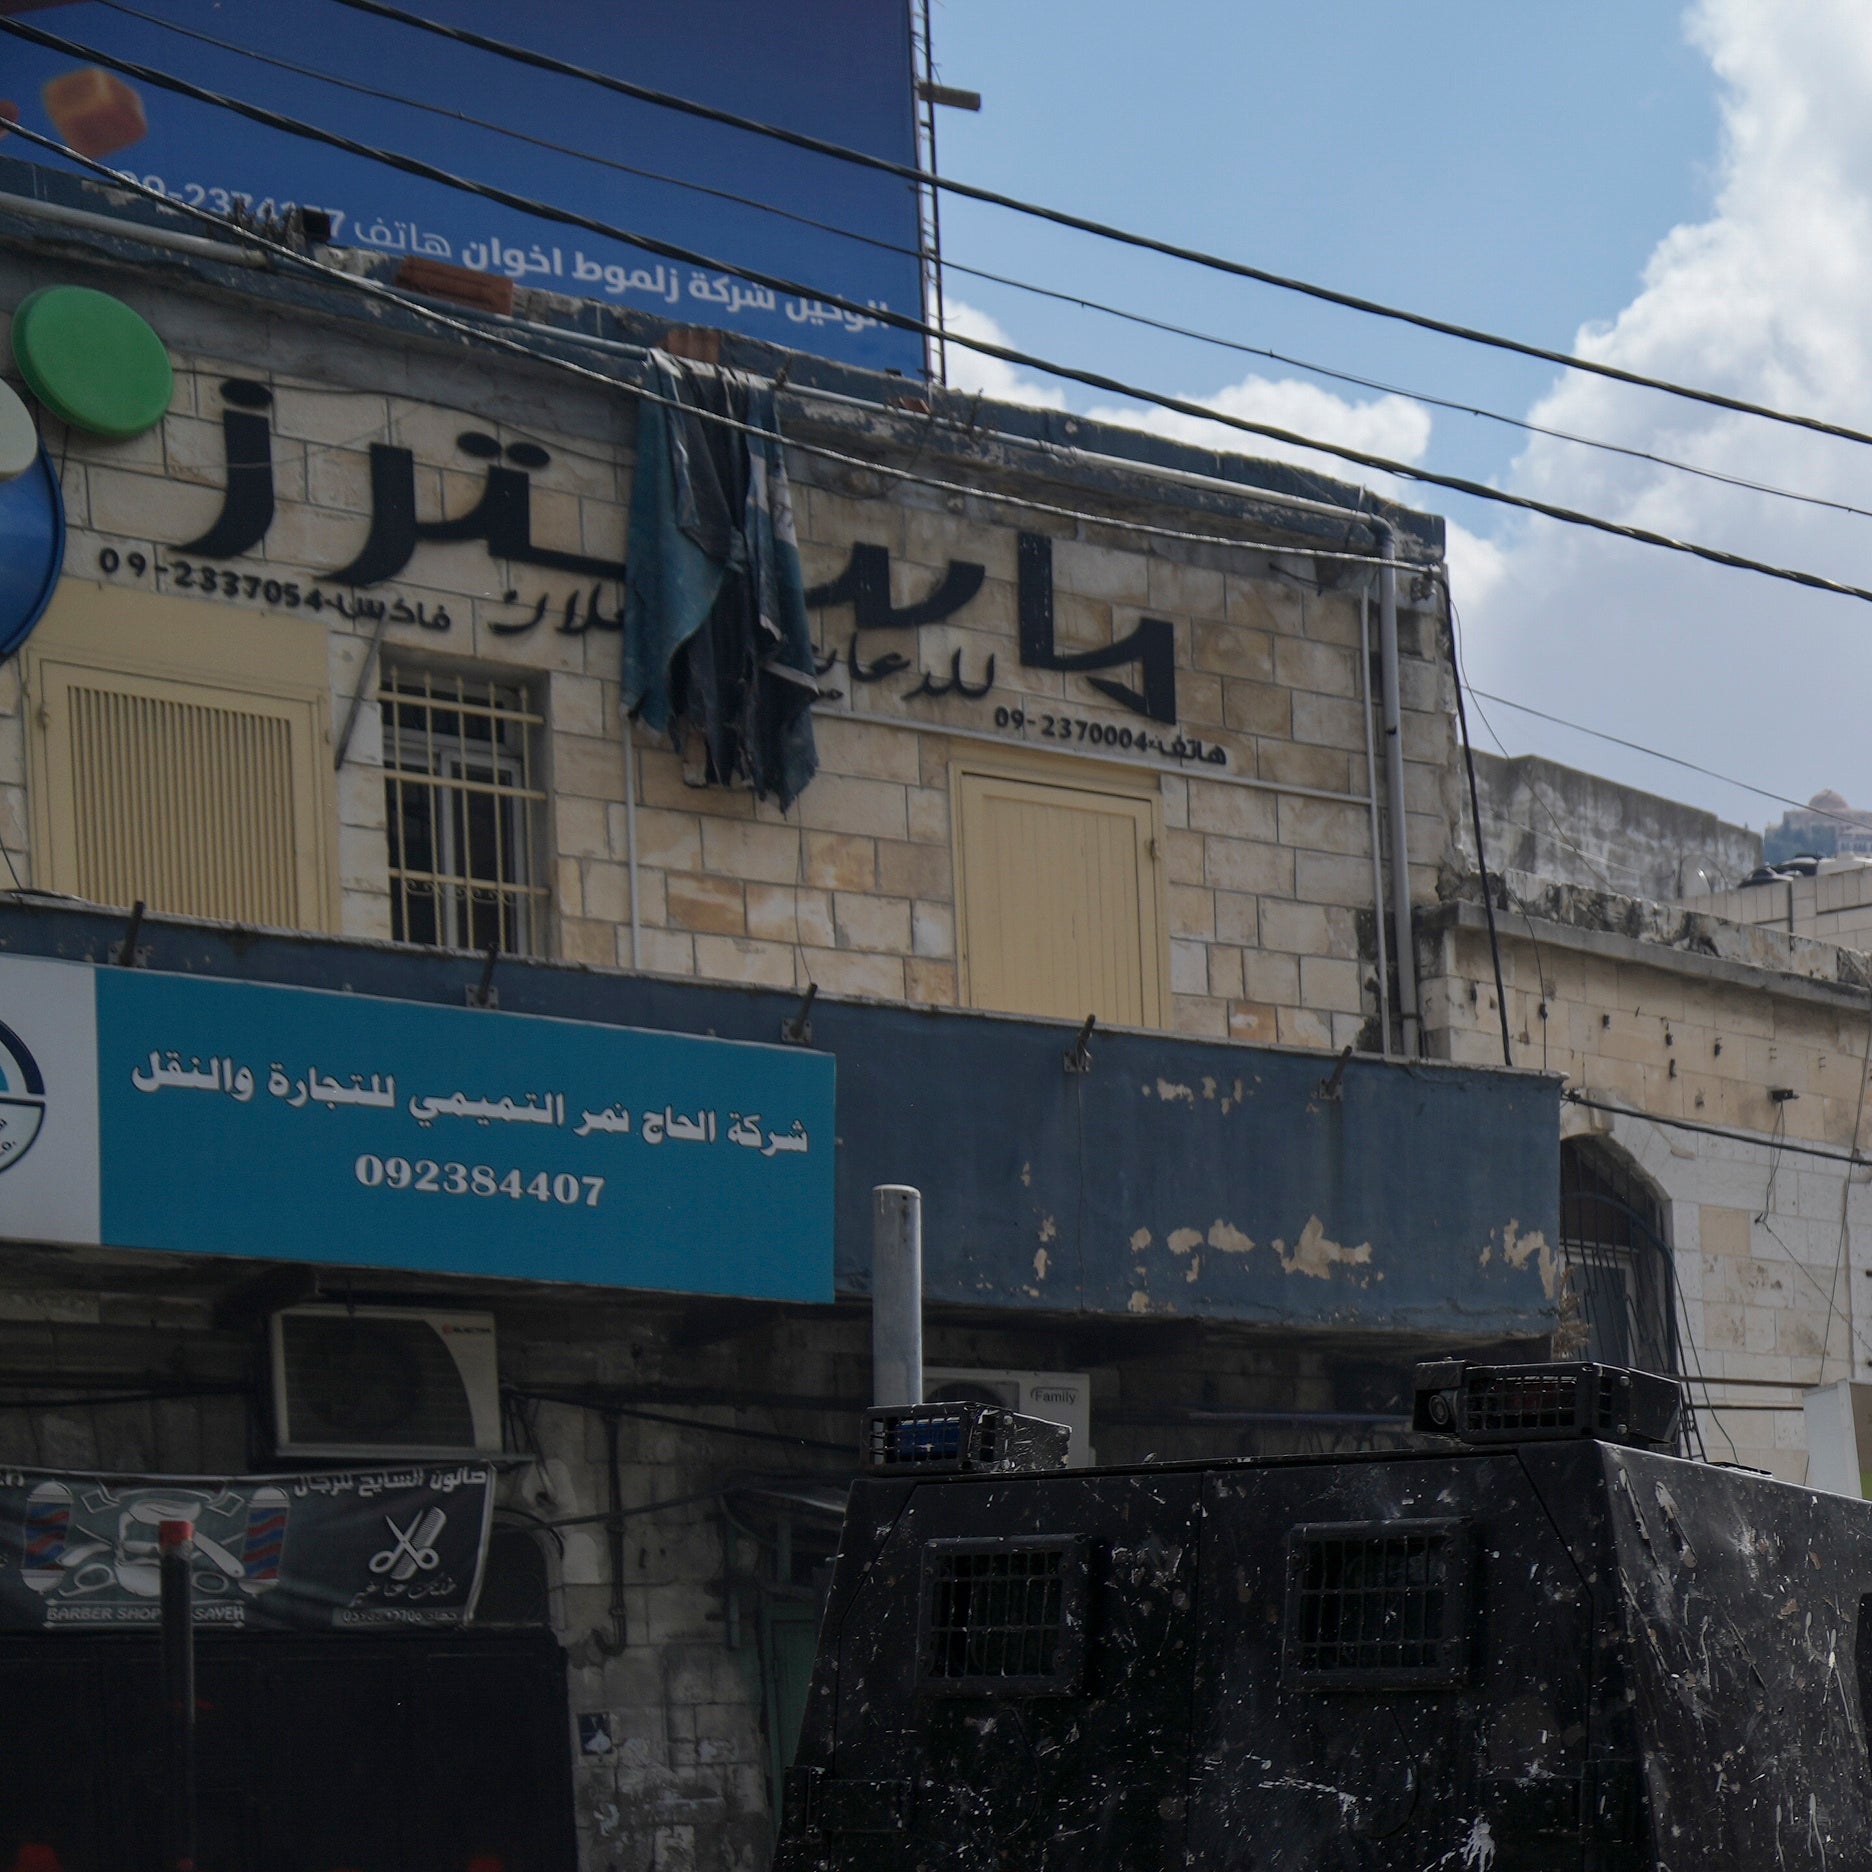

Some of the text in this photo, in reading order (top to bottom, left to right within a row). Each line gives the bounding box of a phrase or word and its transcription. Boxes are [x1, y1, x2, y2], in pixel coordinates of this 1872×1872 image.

[353, 217, 453, 257] هاتف
[462, 236, 563, 275] اخوان
[573, 251, 678, 302] زلموط
[687, 269, 776, 313] شركة
[131, 1050, 809, 1157] شركة الحاج نمر التميمي للتجارة والنقل
[354, 1154, 606, 1207] 092384407
[1035, 1390, 1077, 1404] Family
[430, 1466, 487, 1493] صالون
[46, 1607, 113, 1621] BARBER
[117, 1607, 162, 1620] SHOP
